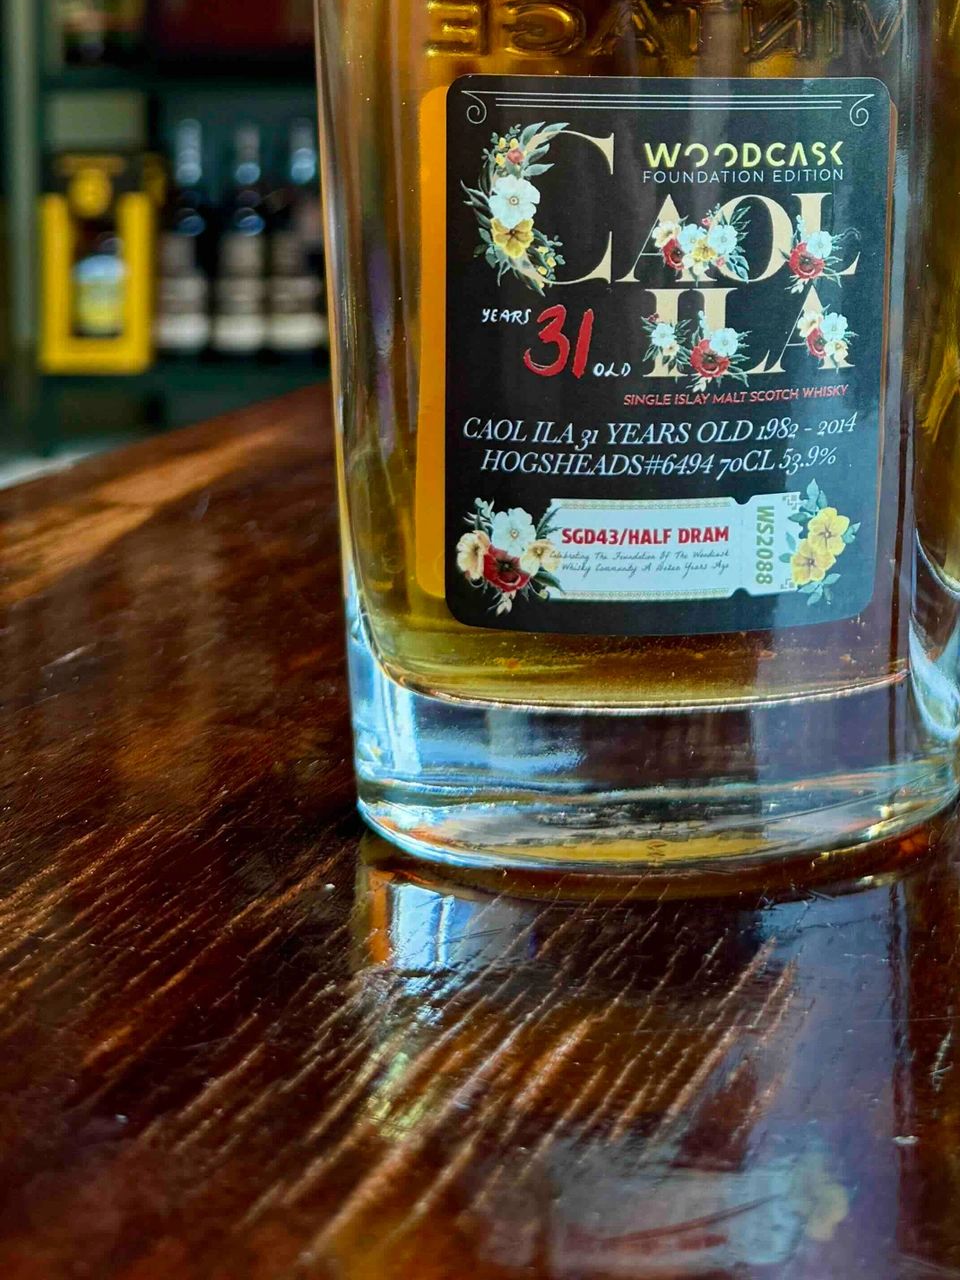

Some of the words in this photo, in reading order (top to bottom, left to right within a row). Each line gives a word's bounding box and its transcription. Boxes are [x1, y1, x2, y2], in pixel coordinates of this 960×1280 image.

[643, 141, 844, 169] WOODCASK
[643, 170, 764, 184] FOUNDATION
[773, 169, 844, 183] EDITION
[480, 128, 860, 286] CAOL
[482, 308, 531, 324] YEARS
[643, 285, 856, 378] ILA
[523, 303, 594, 379] 31
[593, 362, 631, 377] OLD
[624, 393, 671, 407] SINGLE
[674, 392, 709, 405] ISLAY
[711, 390, 746, 404] MALT
[750, 388, 798, 402] SCOTCH
[802, 384, 849, 399] WHISKY
[463, 417, 527, 442] CAOL
[531, 421, 575, 445] ILA
[576, 429, 598, 451] 31
[607, 421, 692, 445] YEARS
[696, 419, 754, 444] OLD
[755, 417, 798, 441] 1982
[817, 412, 859, 435] 2014
[480, 449, 713, 477] HOGSHEADS#6494
[717, 453, 775, 480] 70CL
[778, 446, 838, 475] 53.9%
[561, 527, 672, 546] SGD43/HALF
[677, 526, 729, 543] DRAM
[754, 505, 775, 586] WS2088
